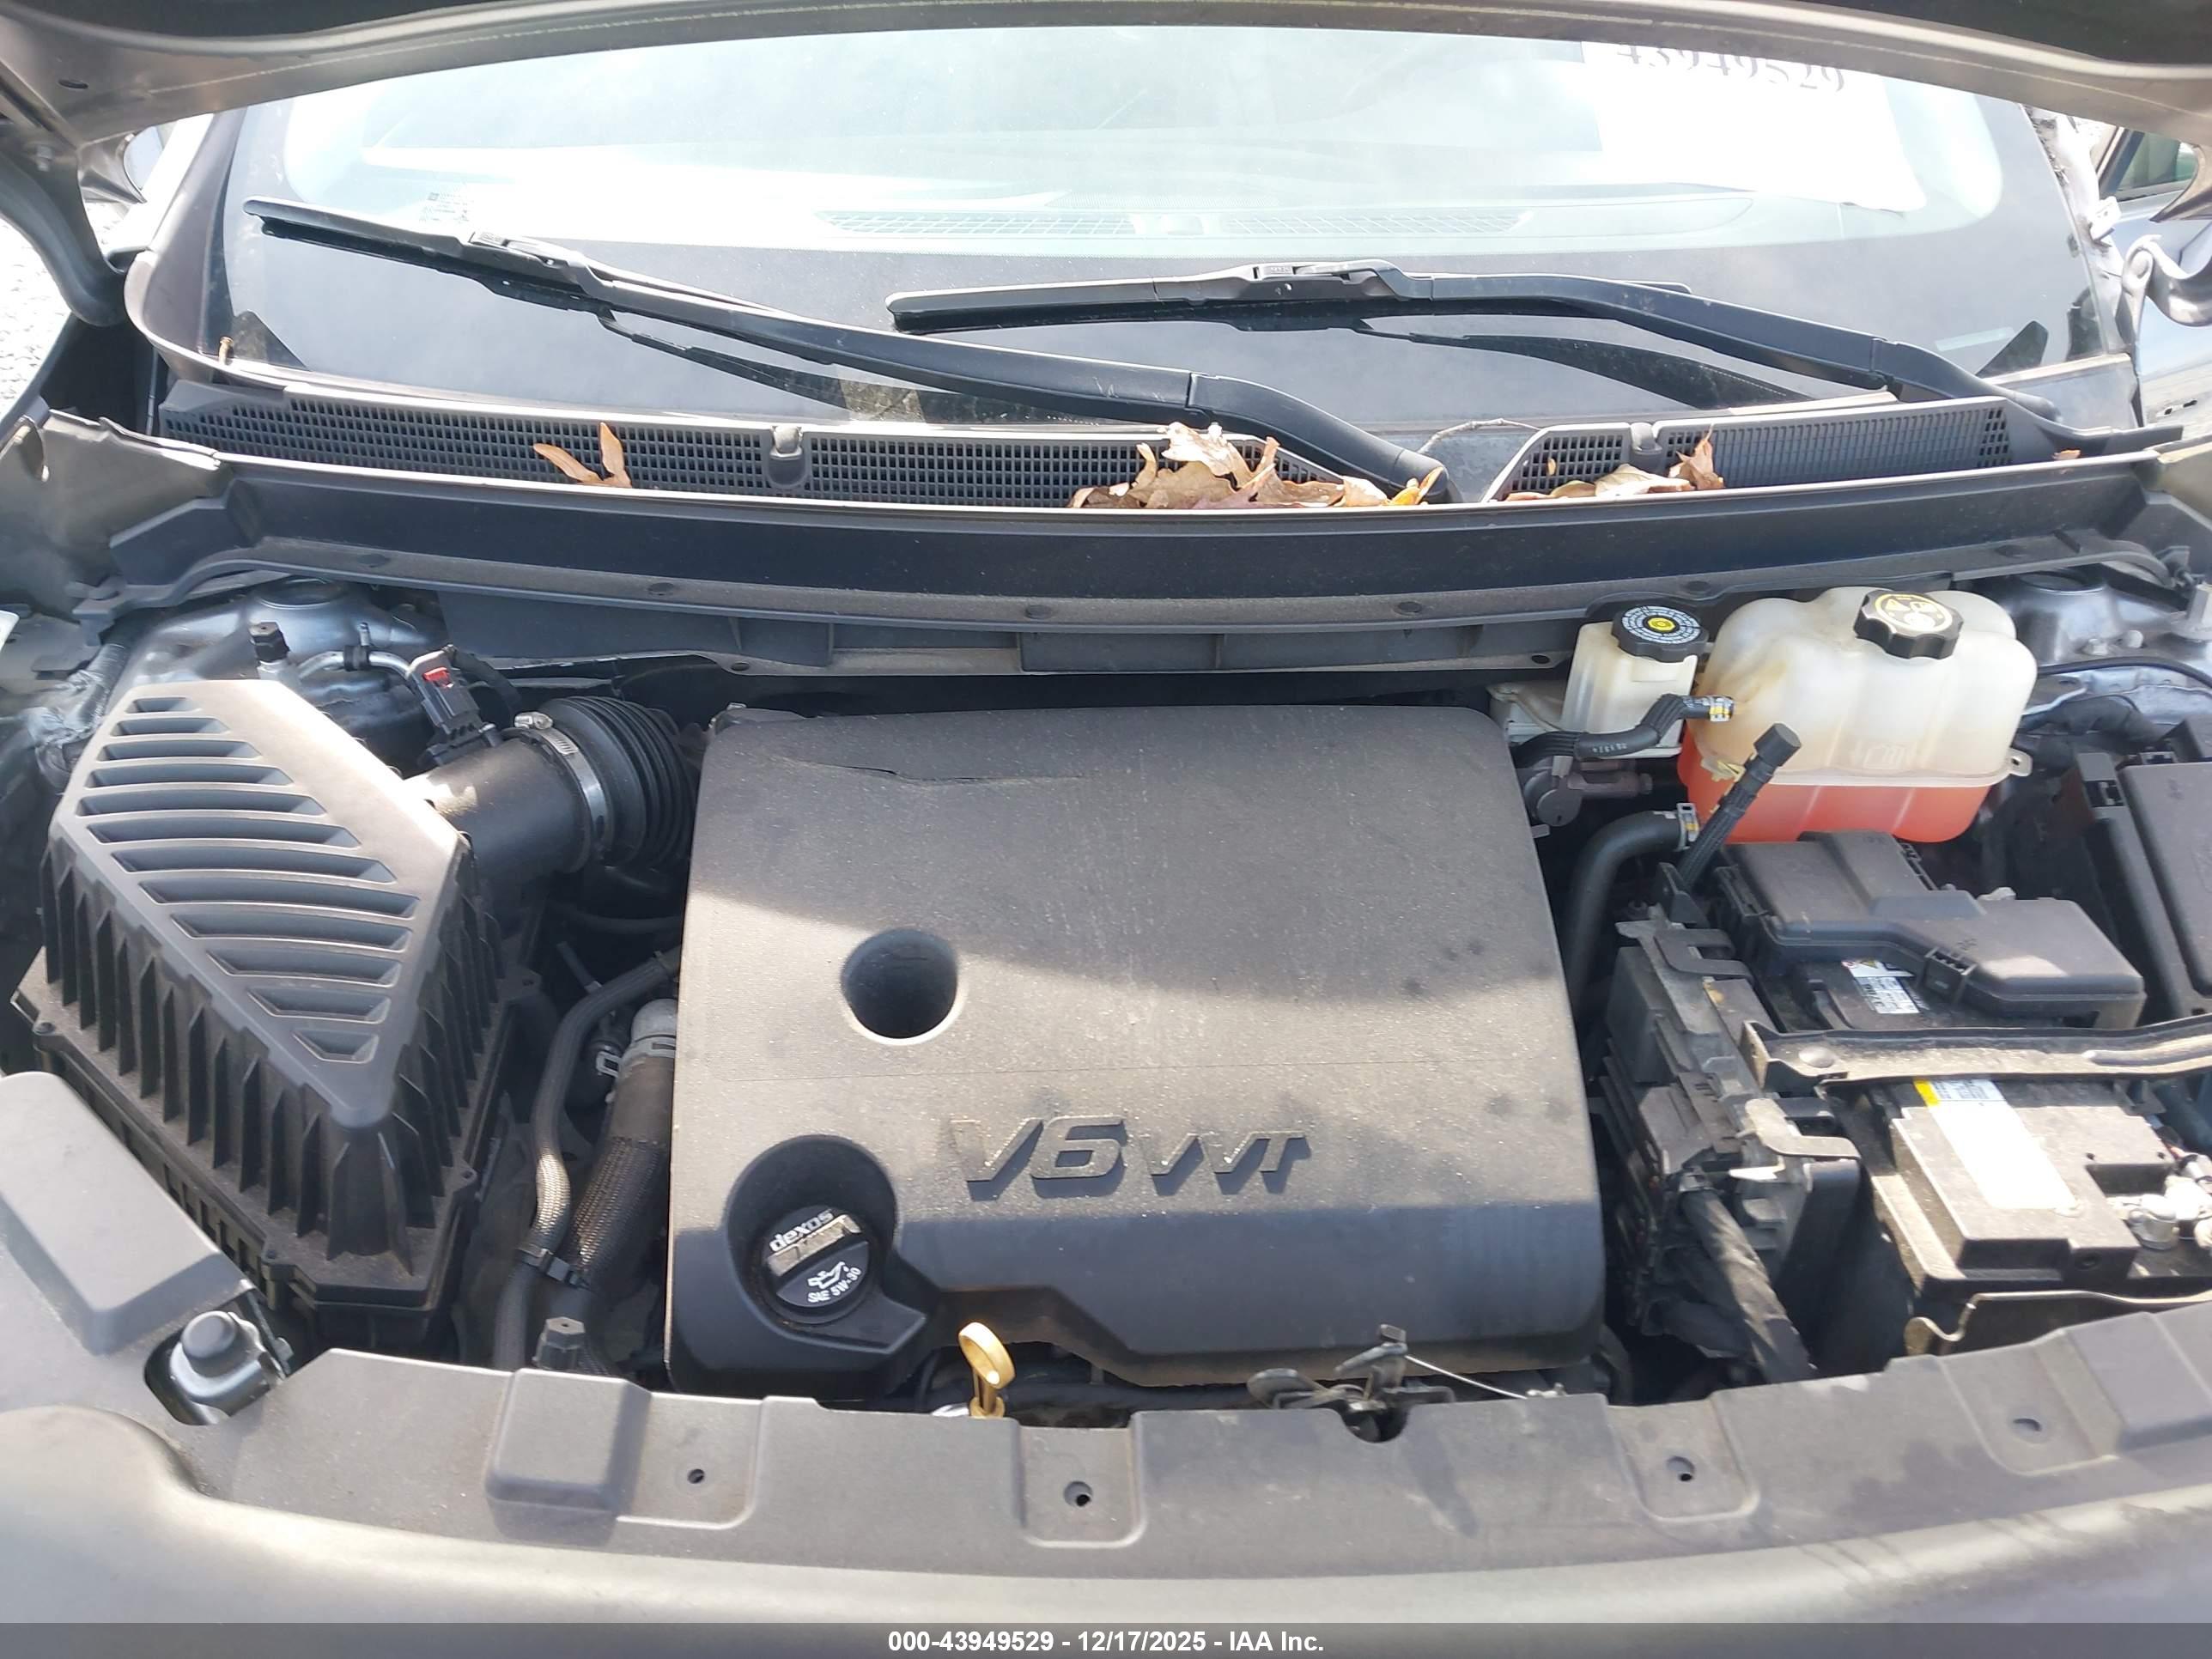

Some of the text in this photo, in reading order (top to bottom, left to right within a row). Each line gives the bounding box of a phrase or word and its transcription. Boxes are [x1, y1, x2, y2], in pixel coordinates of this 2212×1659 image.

[948, 1115, 1126, 1182] V6
[769, 1209, 834, 1252] dexos
[808, 1267, 862, 1303] SAE 5W-30
